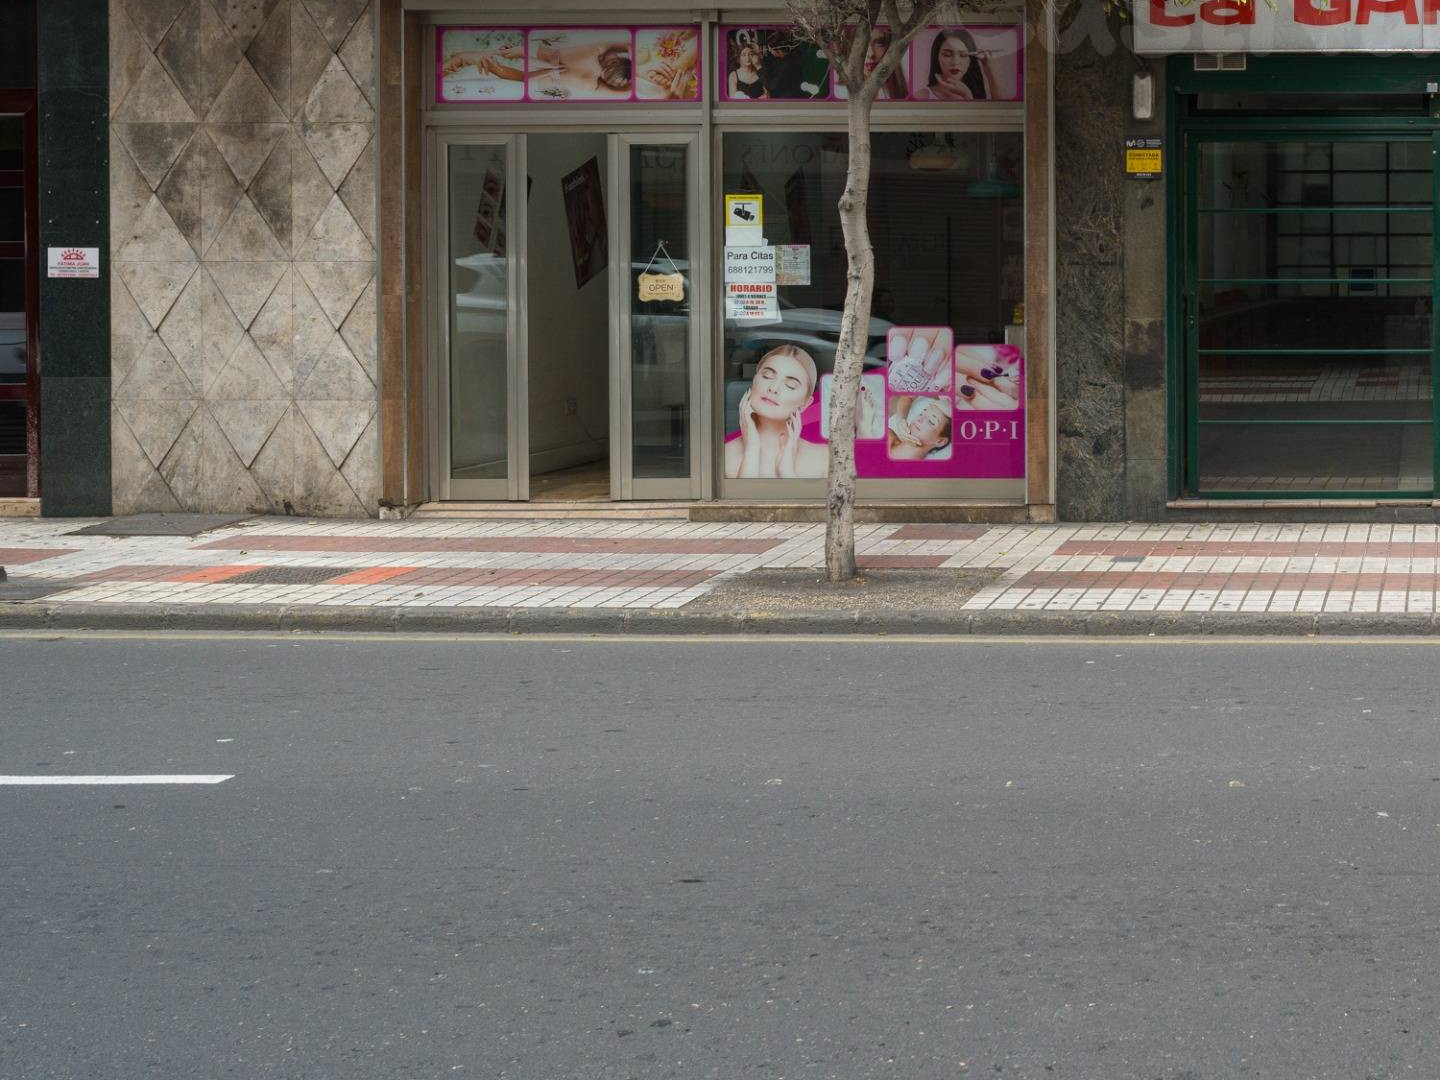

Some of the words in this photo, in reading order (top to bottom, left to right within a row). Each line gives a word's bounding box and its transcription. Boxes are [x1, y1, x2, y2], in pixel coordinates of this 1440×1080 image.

[727, 251, 748, 261] Para
[750, 251, 774, 261] Citas
[727, 266, 774, 275] 688121799
[648, 284, 674, 293] OPEN
[730, 284, 773, 293] HORARIO
